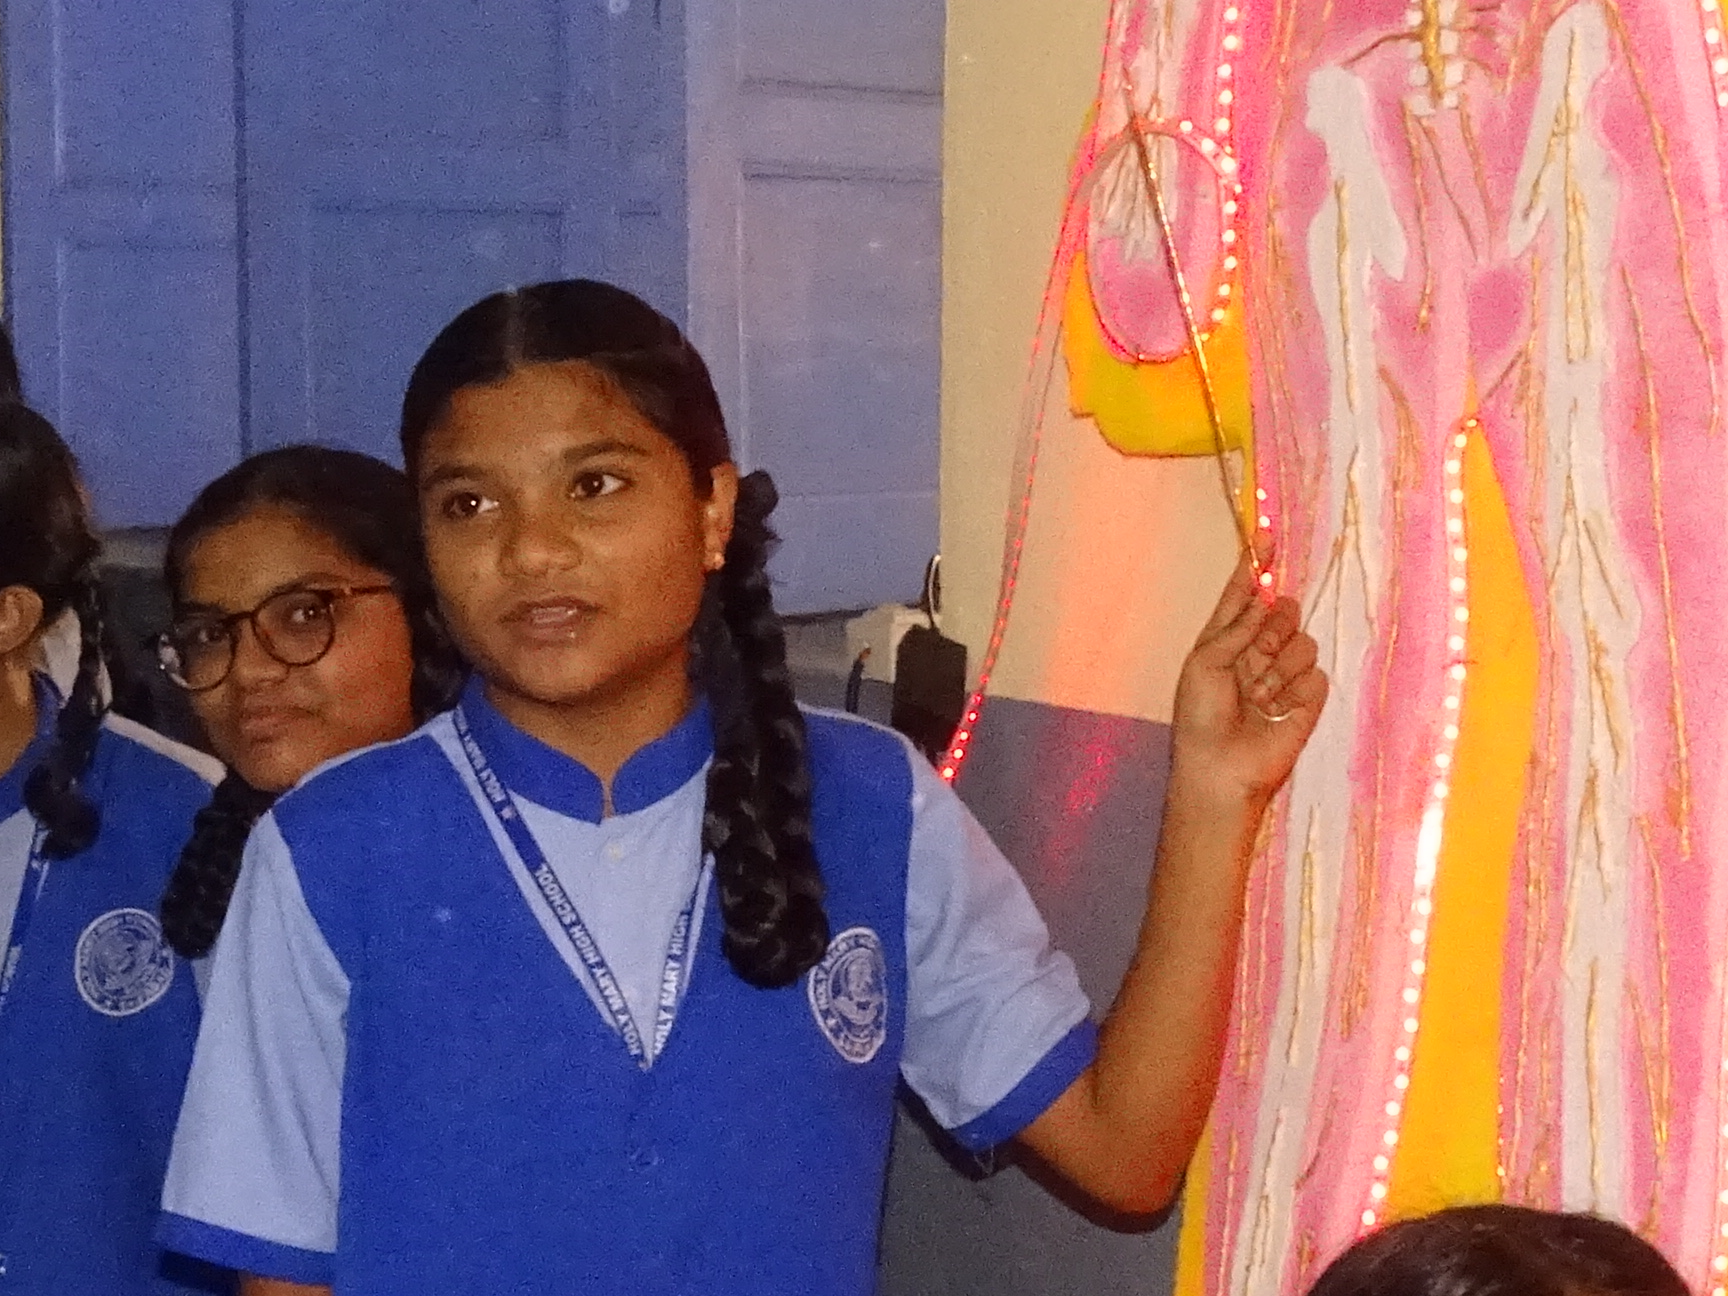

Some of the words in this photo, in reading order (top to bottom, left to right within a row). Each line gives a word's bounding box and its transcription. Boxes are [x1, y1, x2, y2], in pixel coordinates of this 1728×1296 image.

[534, 861, 579, 928] SCHOOL
[570, 921, 602, 968] HIGH
[591, 962, 625, 1012] MARY
[611, 1009, 642, 1057] HOLY
